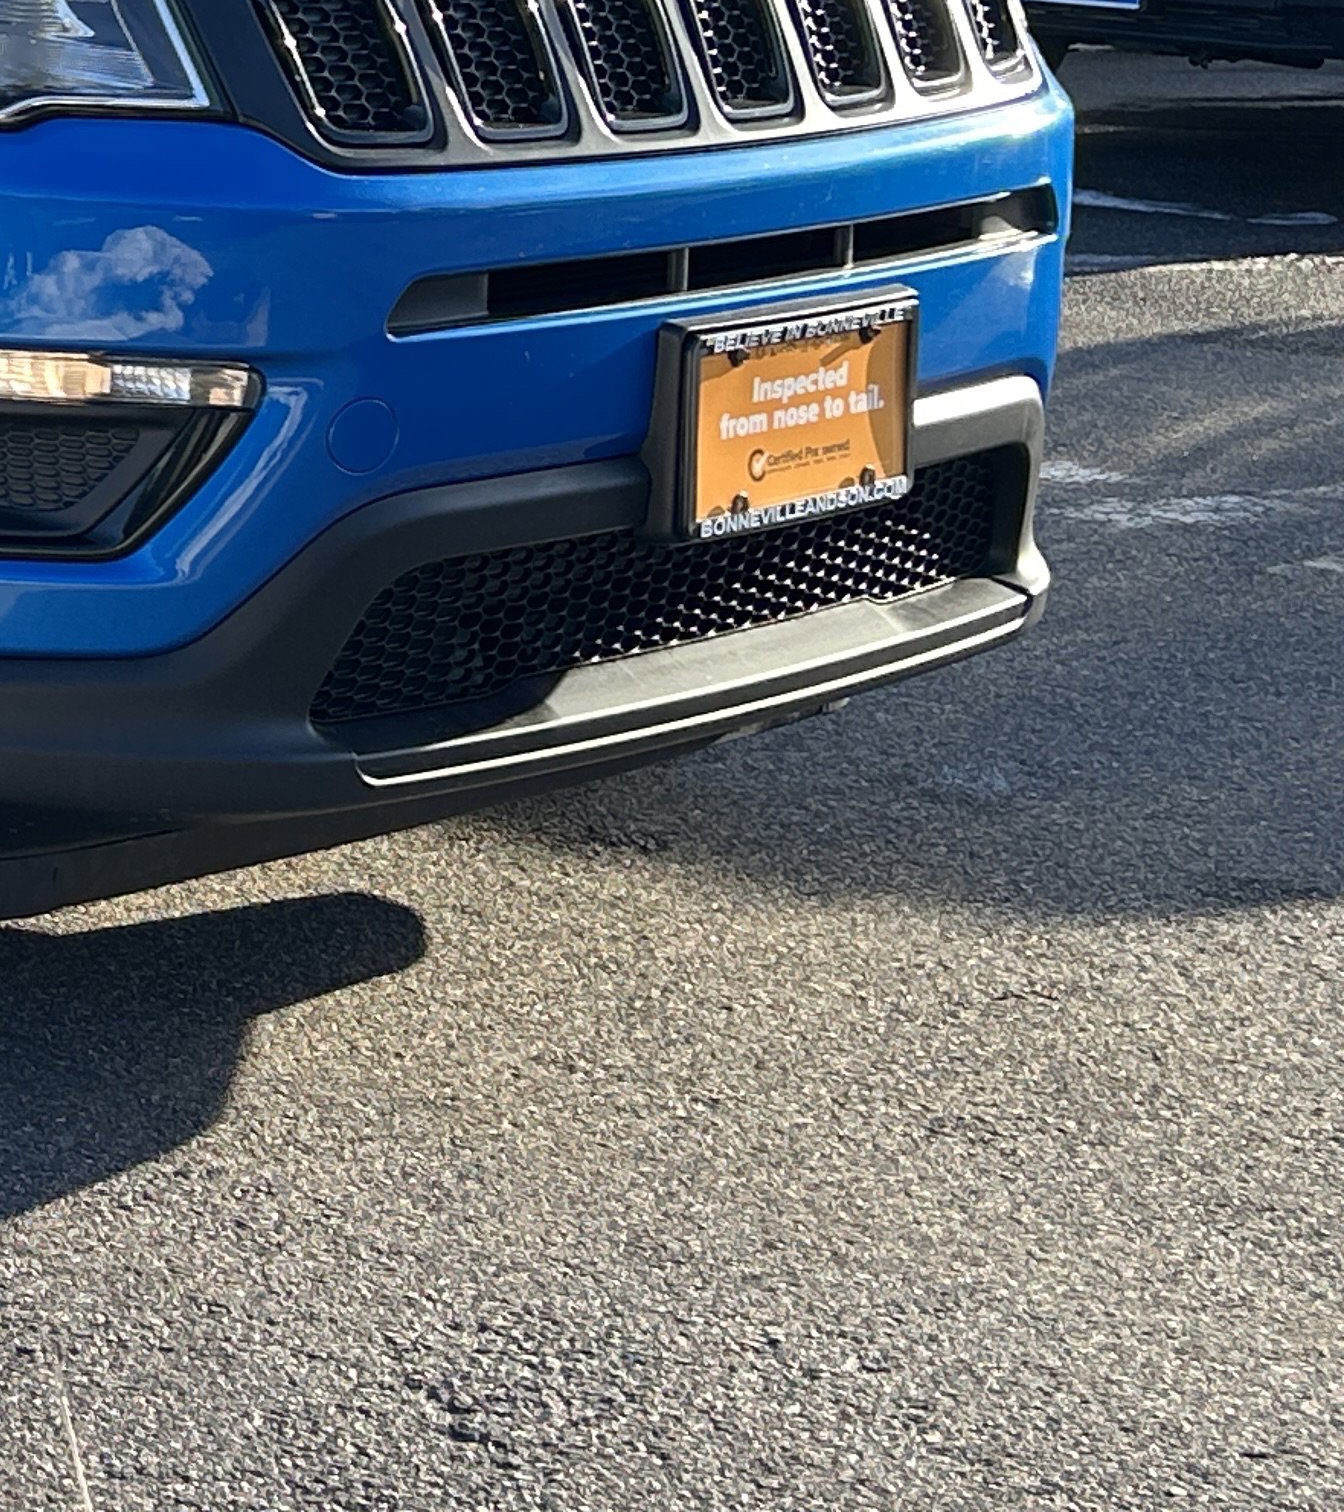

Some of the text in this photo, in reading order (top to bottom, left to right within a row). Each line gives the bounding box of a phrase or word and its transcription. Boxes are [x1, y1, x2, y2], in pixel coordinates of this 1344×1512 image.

[785, 327, 803, 342] IN
[752, 360, 849, 403] Inspected
[720, 384, 885, 440] from nose to tail.
[700, 475, 908, 538] BONNEVILLEANDSON.COM
